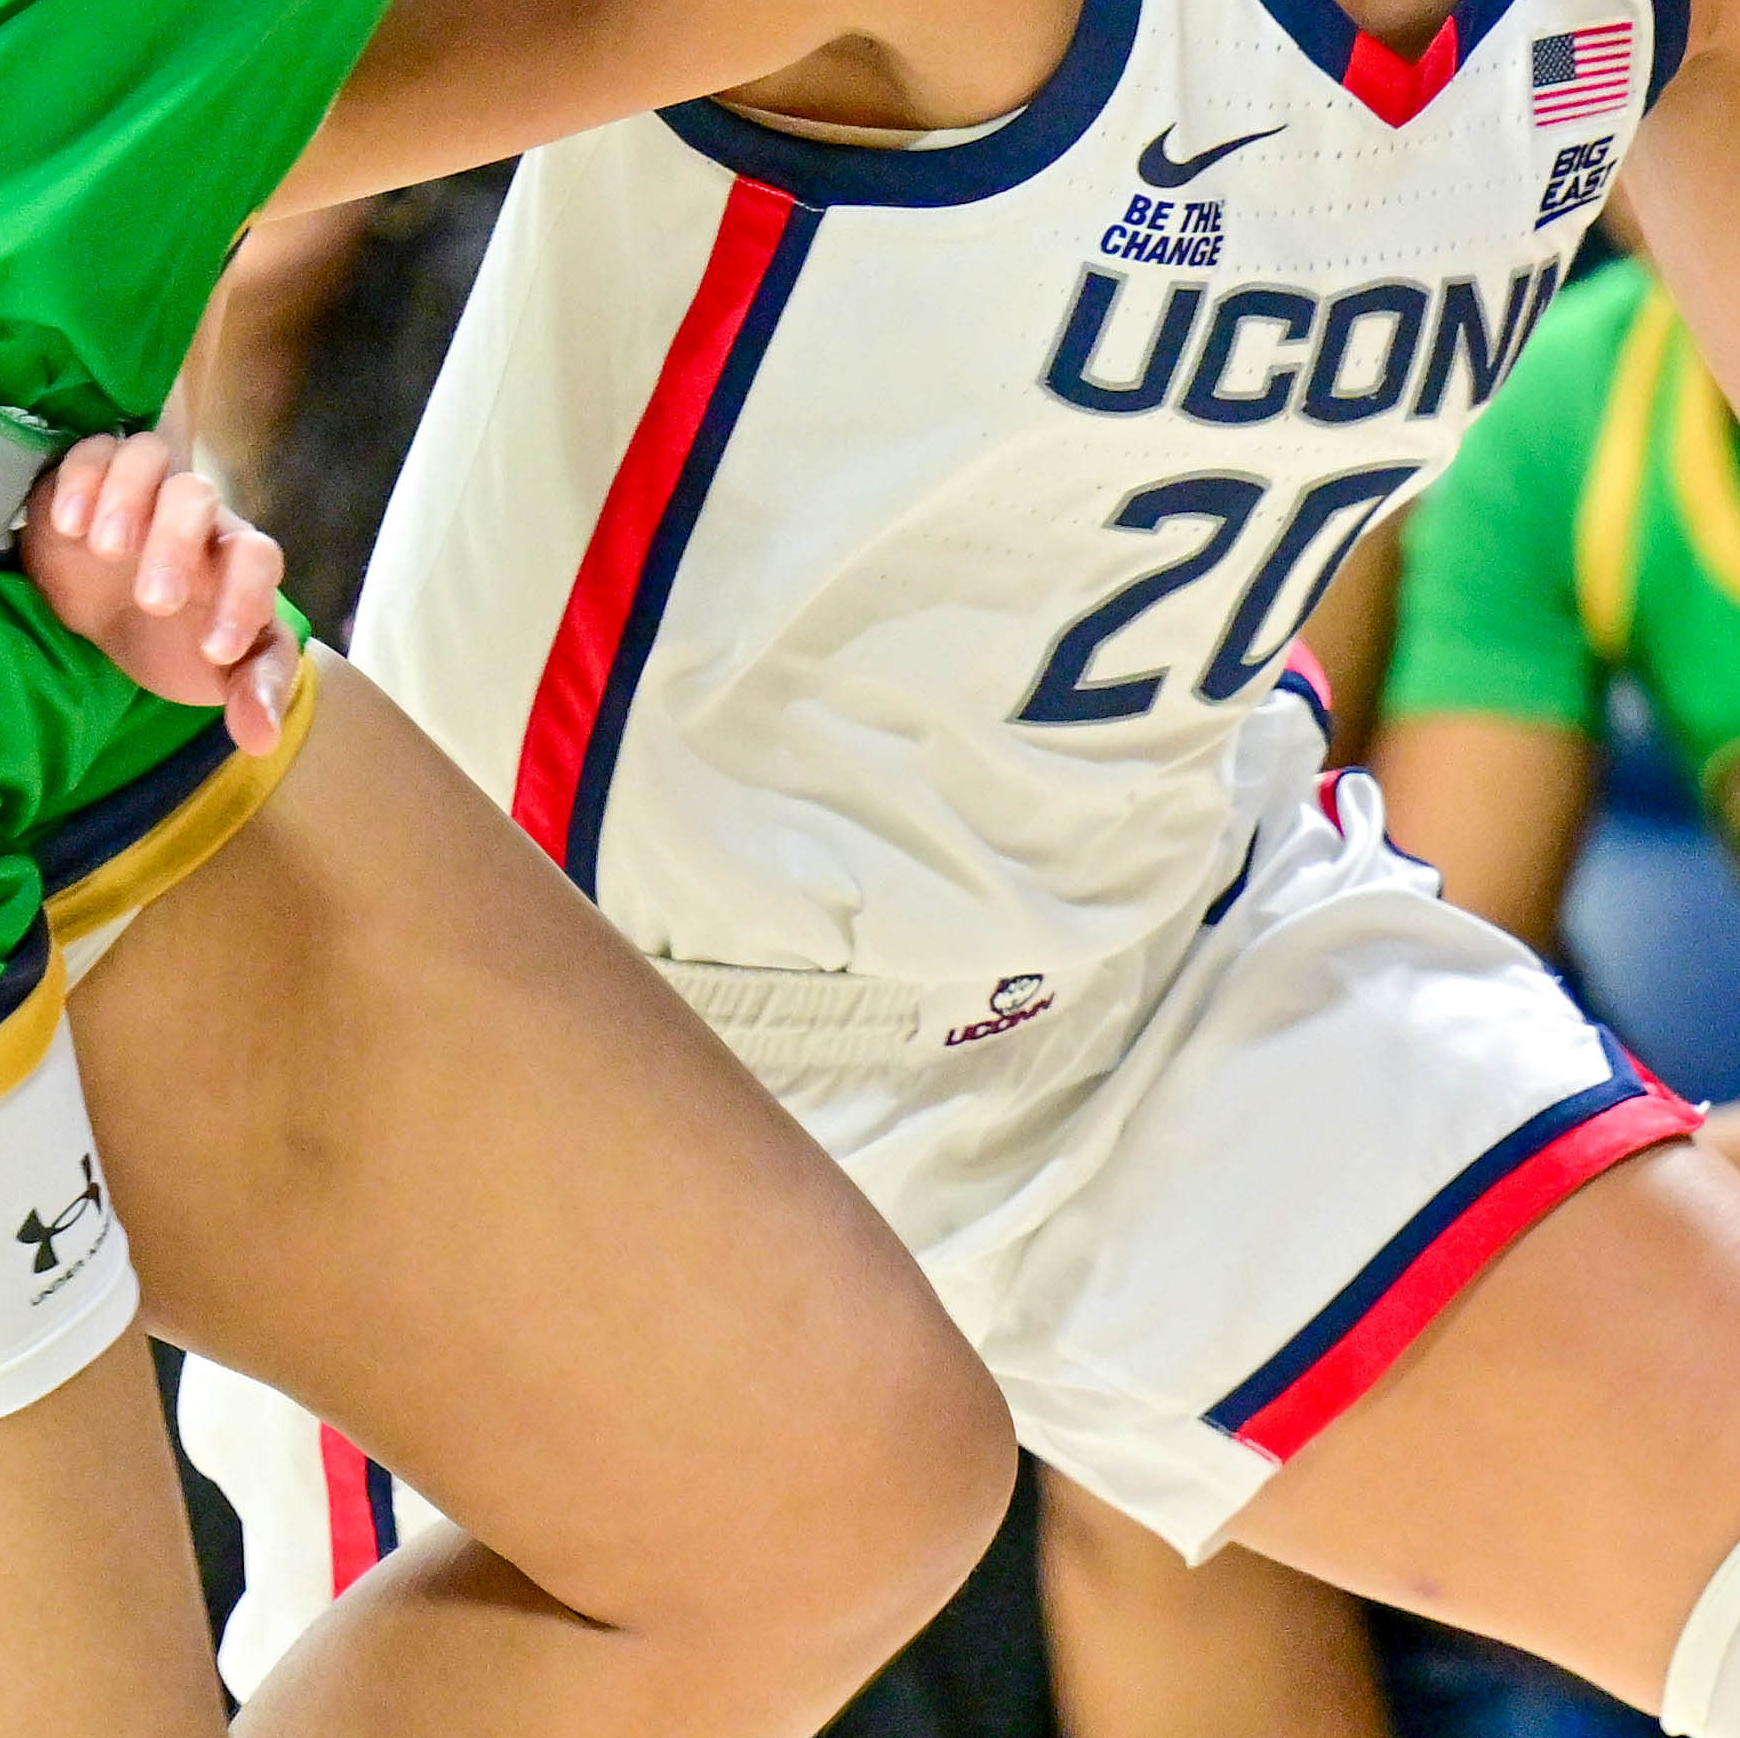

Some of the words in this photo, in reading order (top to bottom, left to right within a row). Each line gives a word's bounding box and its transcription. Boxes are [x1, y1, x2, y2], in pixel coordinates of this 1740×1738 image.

[1551, 134, 1615, 179] BIG
[1540, 158, 1618, 212] EAST
[1123, 193, 1175, 231] BE
[1179, 200, 1225, 233] THE
[1100, 224, 1224, 266] CHANGE
[1006, 459, 1427, 725] 20
[944, 991, 1056, 1047] UCONN
